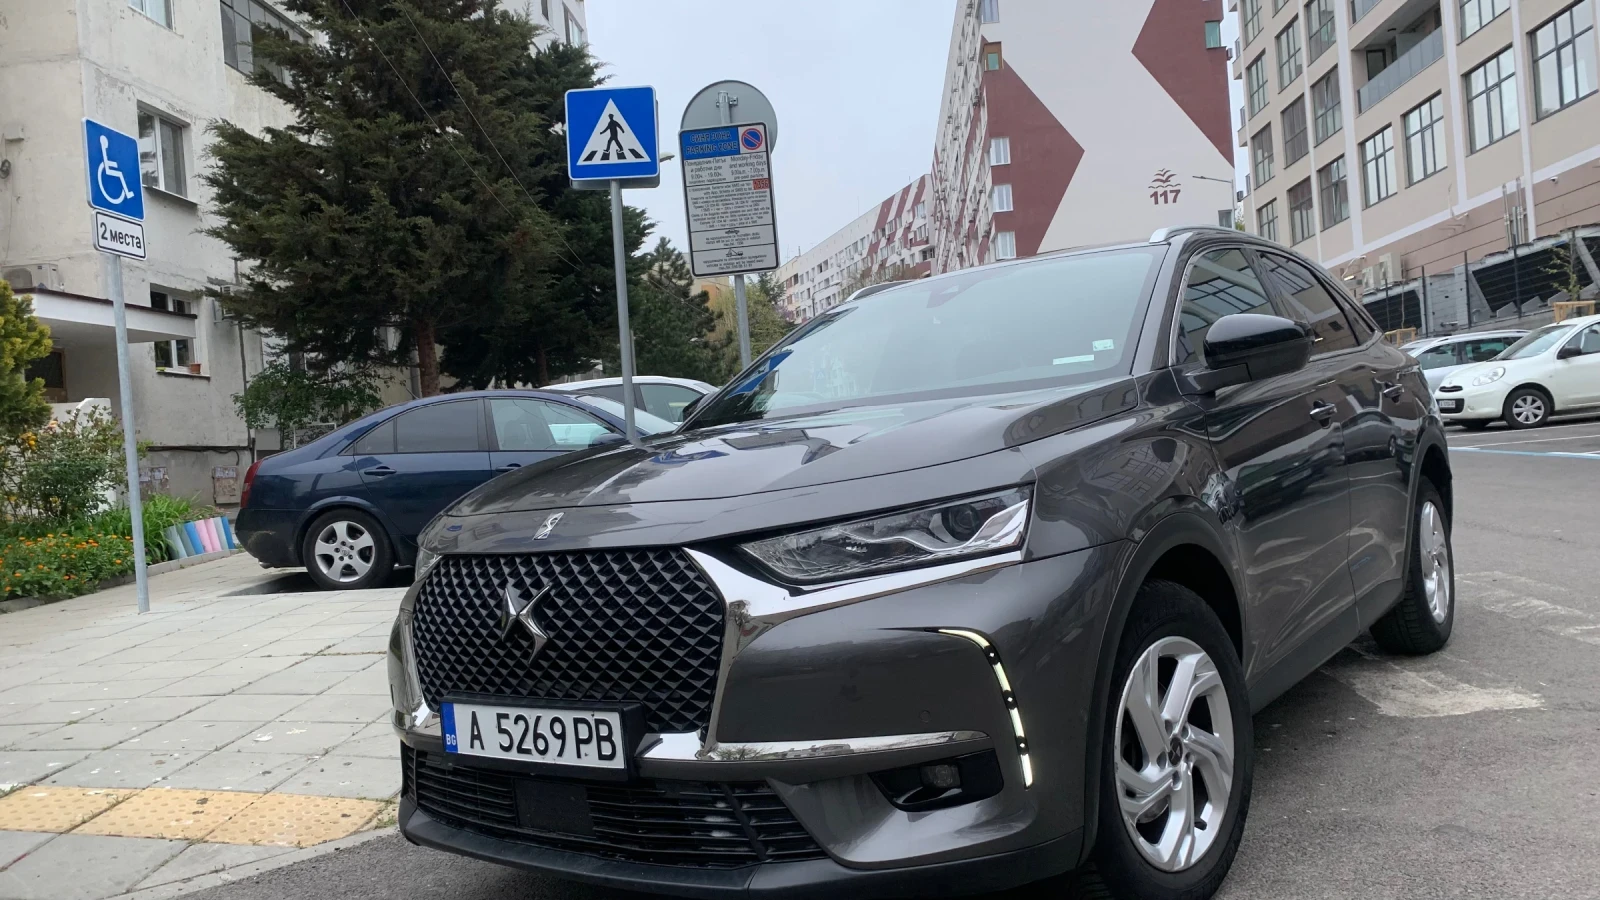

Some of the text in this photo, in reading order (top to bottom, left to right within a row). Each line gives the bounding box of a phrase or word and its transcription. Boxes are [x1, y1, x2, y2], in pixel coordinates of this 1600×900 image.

[691, 131, 731, 143] СИНЯ ЗОНА
[686, 141, 738, 155] PARKING ZONE
[738, 161, 756, 169] working
[1150, 189, 1181, 205] 117
[100, 222, 142, 249] 2 места
[469, 711, 485, 750] A
[446, 734, 457, 746] BG
